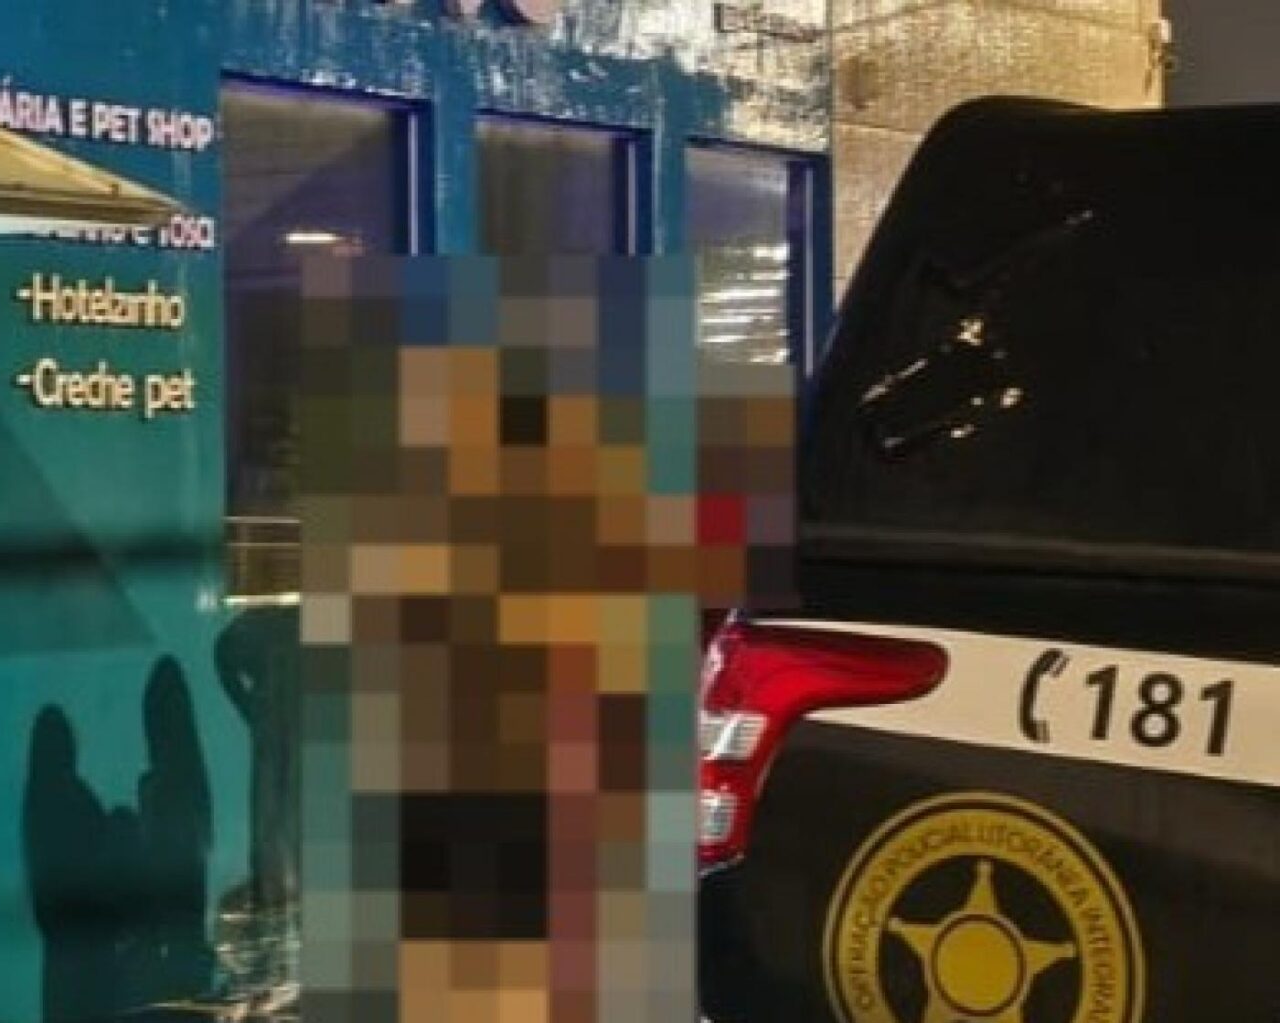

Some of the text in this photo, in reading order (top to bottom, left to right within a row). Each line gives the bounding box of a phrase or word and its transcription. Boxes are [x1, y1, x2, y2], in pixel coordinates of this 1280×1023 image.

[70, 99, 87, 136] E
[92, 103, 141, 142] PET
[147, 108, 214, 151] SHOP
[144, 367, 196, 419] pet
[1084, 663, 1236, 758] 181
